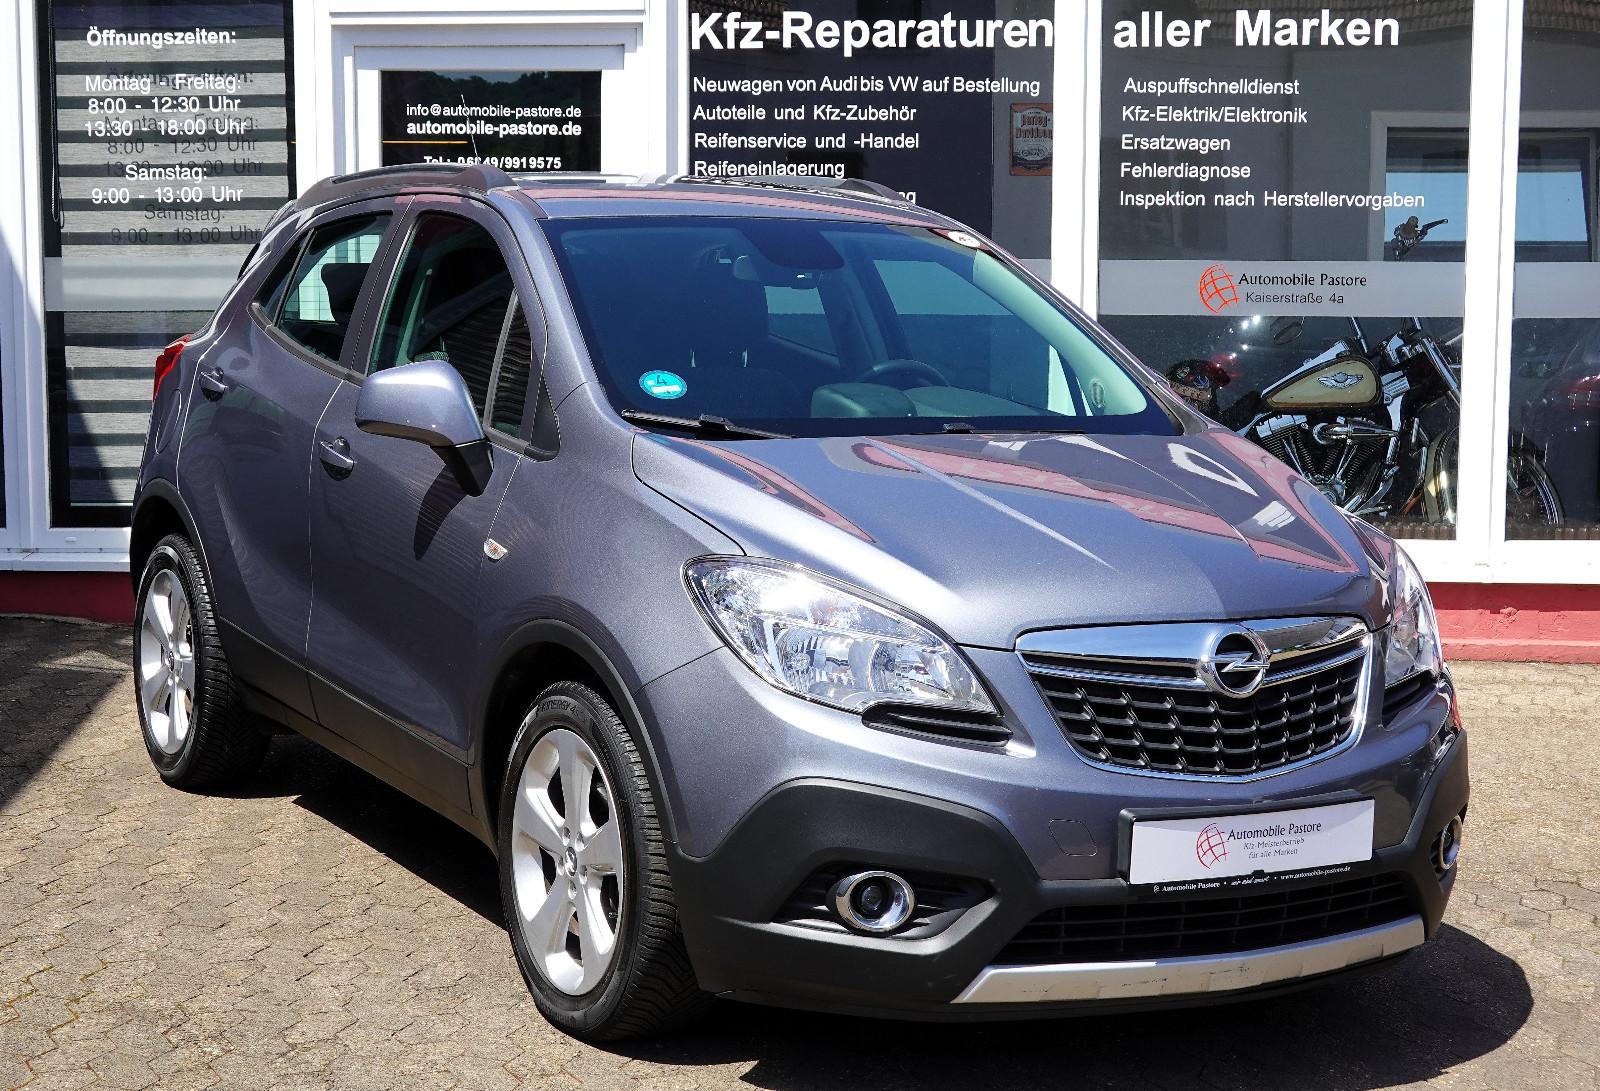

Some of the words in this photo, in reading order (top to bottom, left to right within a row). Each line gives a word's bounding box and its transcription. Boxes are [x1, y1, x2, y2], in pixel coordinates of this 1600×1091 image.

[86, 26, 237, 49] Öffnungszeiten:
[690, 11, 1054, 58] Kfz-Reparaturen
[1113, 10, 1212, 48] aller
[1235, 9, 1400, 47] Marken
[84, 75, 151, 94] Montag
[175, 73, 242, 93] Freitag:
[694, 77, 782, 95] Neuwagen
[787, 80, 816, 91] von
[820, 76, 857, 91] Audi
[861, 76, 883, 91] bis
[888, 76, 918, 91] VW
[923, 77, 949, 92] auf
[954, 77, 1040, 96] Bestellung
[1124, 78, 1299, 96] Auspuffschnelldienst
[88, 98, 127, 114] 8:00
[151, 97, 200, 113] 12:30
[208, 95, 241, 112] Uhr
[406, 103, 582, 118] info@automobile-pastore.de
[693, 105, 765, 120] Autoteile
[775, 105, 804, 120] und
[814, 105, 916, 120] Kfz-Zubehör
[1123, 106, 1307, 122] Kfz-Elektrik/Elektronik
[85, 120, 133, 137] 13:30
[158, 119, 206, 136] 18:00
[215, 119, 247, 135] Uhr
[406, 120, 582, 138] automobile-pastore.de
[695, 133, 806, 148] Reifenservice
[816, 133, 845, 148] und
[854, 133, 918, 148] -Handel
[1122, 134, 1230, 154] Ersatzwagen
[125, 164, 208, 184] Samstag:
[694, 159, 845, 178] Reifeneinlagerung
[1121, 163, 1250, 181] Fehlerdiagnose
[91, 187, 130, 204] 9:00
[154, 186, 203, 203] 13:00
[211, 186, 244, 202] Uhr
[1121, 191, 1205, 209] Inspektion
[1215, 191, 1254, 206] nach
[1265, 191, 1424, 210] Herstellervorgaben
[1239, 273, 1315, 286] Automobile
[1320, 273, 1368, 287] Pastore
[1246, 291, 1323, 304] Kaiserstraße
[1328, 292, 1344, 304] 4a
[1228, 825, 1286, 841] Automobile
[1288, 822, 1322, 835] Pastore
